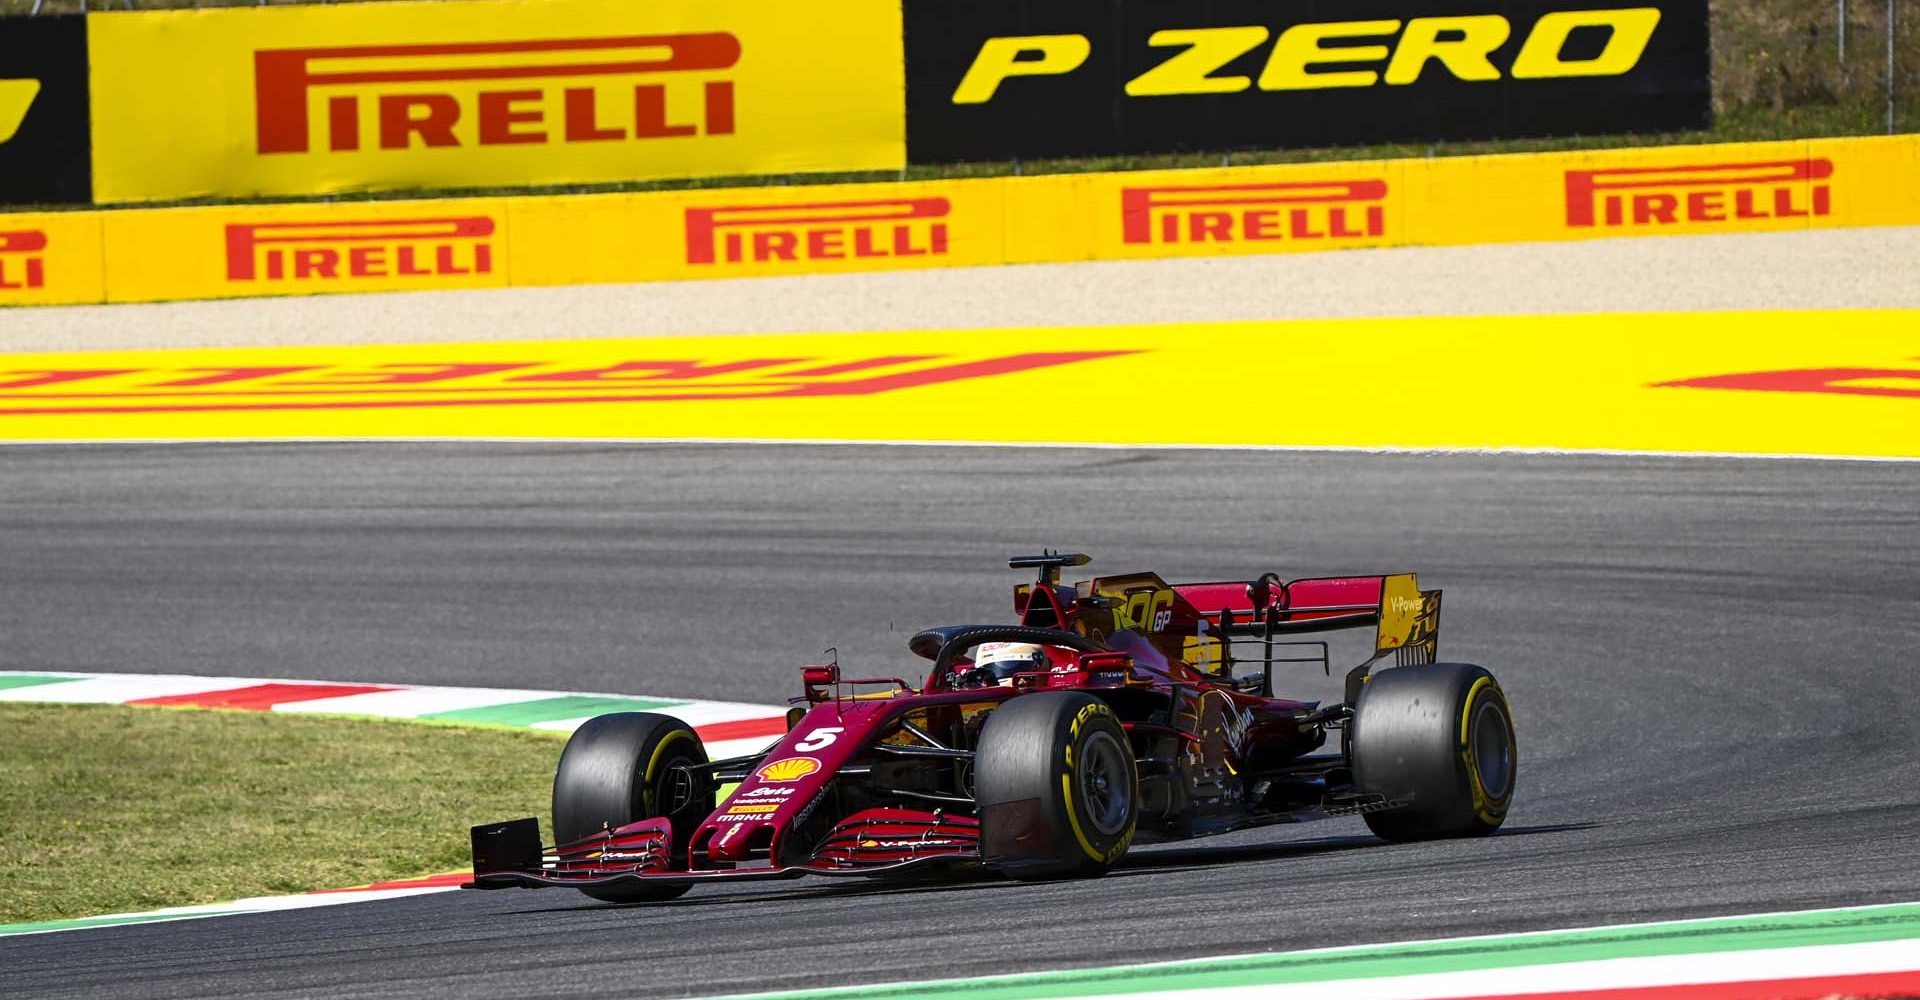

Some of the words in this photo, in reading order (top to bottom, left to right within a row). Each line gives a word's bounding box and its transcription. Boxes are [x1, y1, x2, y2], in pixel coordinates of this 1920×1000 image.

[953, 35, 1090, 104] P
[1125, 7, 1661, 96] ZERO
[255, 32, 742, 155] PIRELLI
[1122, 179, 1387, 244] PIRELLI
[1564, 158, 1833, 228] PIRELLI
[226, 216, 494, 281] PIRELLI
[685, 197, 951, 265] PIRELLI
[0, 351, 1145, 414] PIRELL
[1153, 610, 1172, 632] GP
[795, 726, 845, 753] 5
[716, 813, 775, 822] MAHLE
